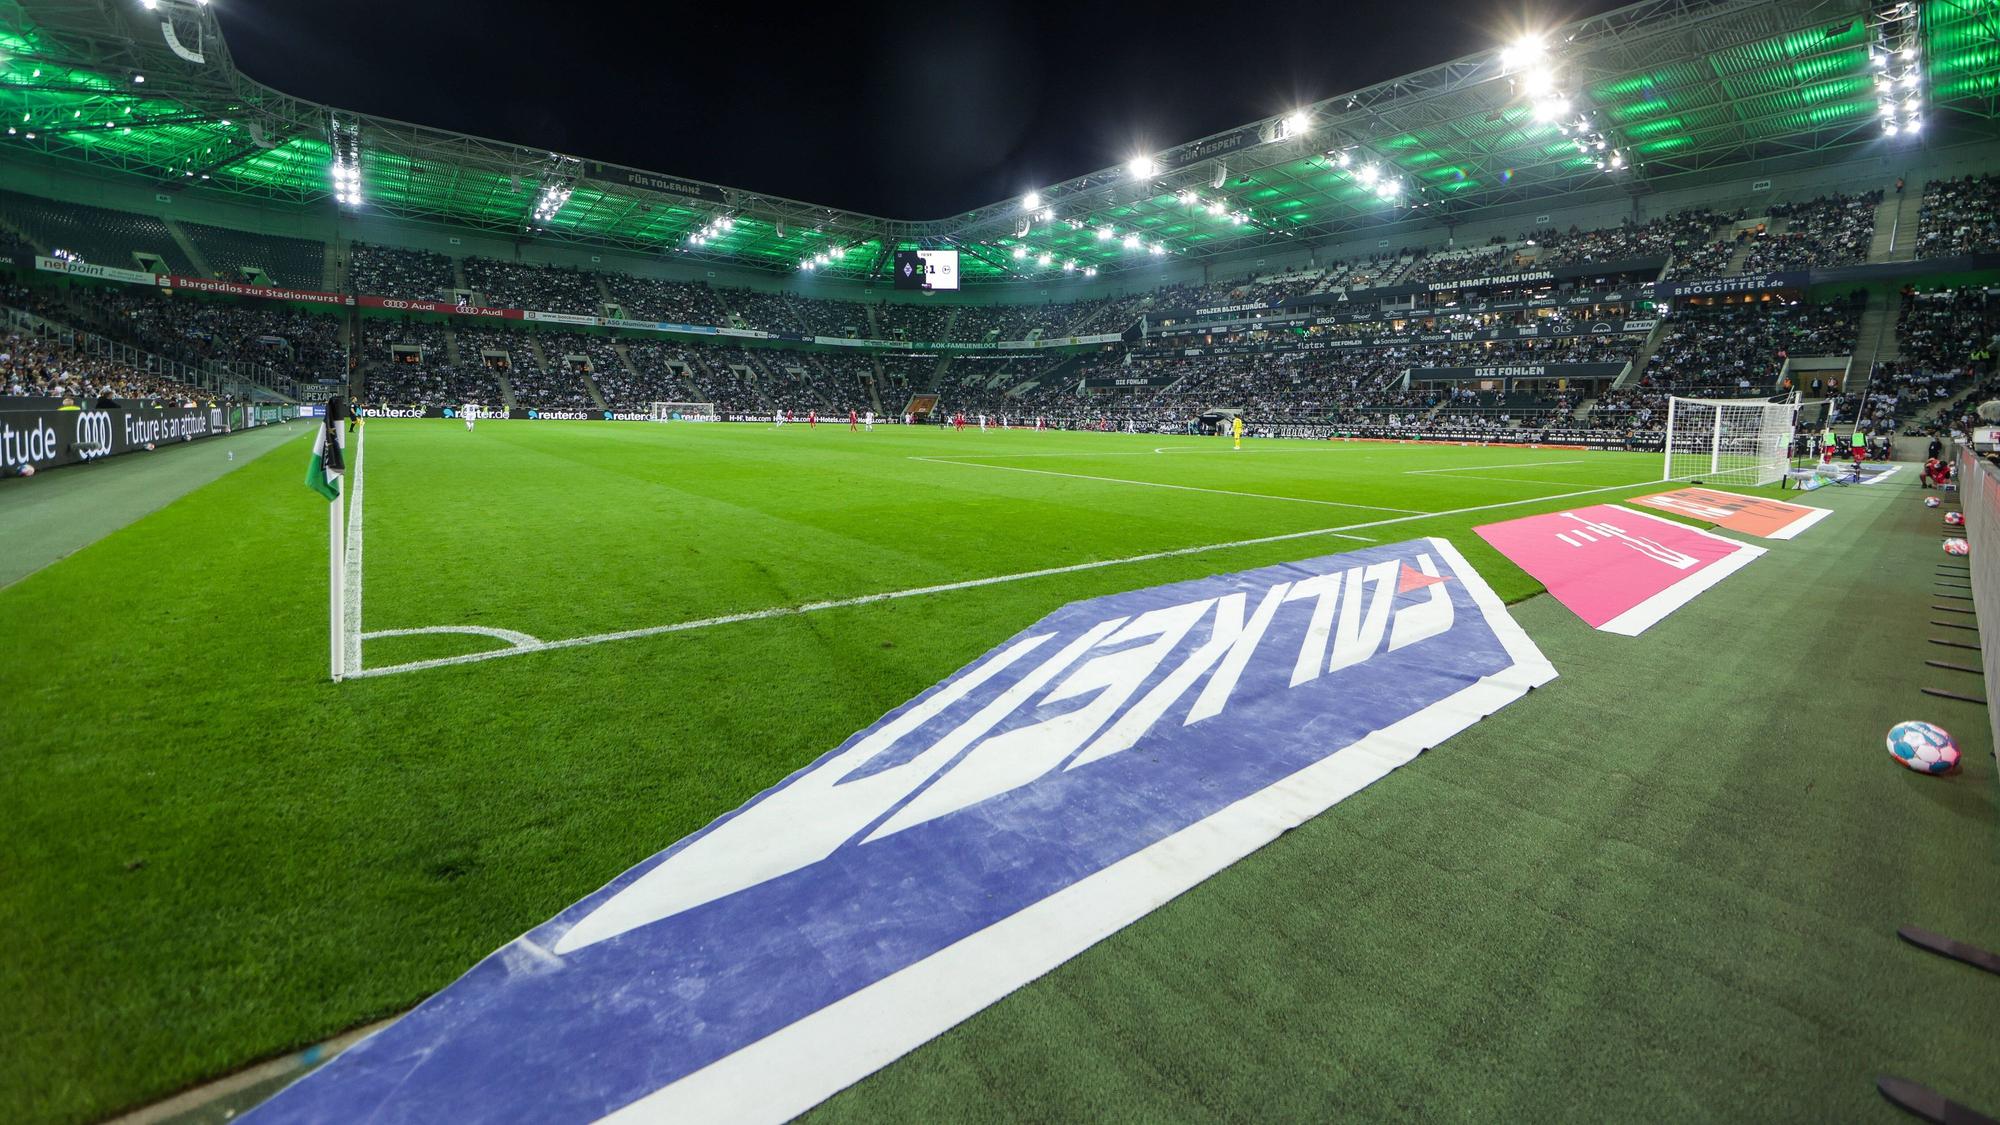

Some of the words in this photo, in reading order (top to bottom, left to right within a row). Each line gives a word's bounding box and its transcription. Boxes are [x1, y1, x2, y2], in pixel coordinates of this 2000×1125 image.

[628, 173, 649, 185] FÜR
[651, 179, 701, 195] TOLERANZ
[44, 259, 104, 276] netpoint
[1428, 281, 1458, 291] VOLLE
[1460, 277, 1492, 288] KRAFT
[1492, 274, 1519, 284] NACH
[1521, 271, 1554, 281] VORN.
[179, 278, 243, 293] Bargeldlos
[245, 287, 264, 296] zur
[266, 289, 339, 303] Stadionwurst
[1675, 280, 1784, 295] BROGSITTER.de
[411, 302, 435, 311] Audi
[1196, 306, 1221, 316] STOLZER
[1222, 304, 1241, 313] BLICK
[1241, 301, 1269, 311] ZURÜCK.
[481, 308, 503, 316] Audi
[622, 320, 656, 329] Aluminium
[1316, 317, 1336, 325] ERGO
[1552, 325, 1572, 334] OLS
[1297, 342, 1325, 350] flatex
[1380, 337, 1411, 345] Santander
[1475, 367, 1496, 377] DIE
[1498, 366, 1545, 376] FOHLEN
[362, 407, 423, 418] reuter.de
[538, 410, 588, 420] reuter.de
[613, 411, 658, 421] reuter.de
[681, 413, 721, 422] reuter.de
[125, 413, 160, 445] Future
[160, 412, 168, 439] is
[170, 419, 180, 437] an
[180, 411, 206, 436] attitude
[553, 553, 1457, 956] FALKEN
